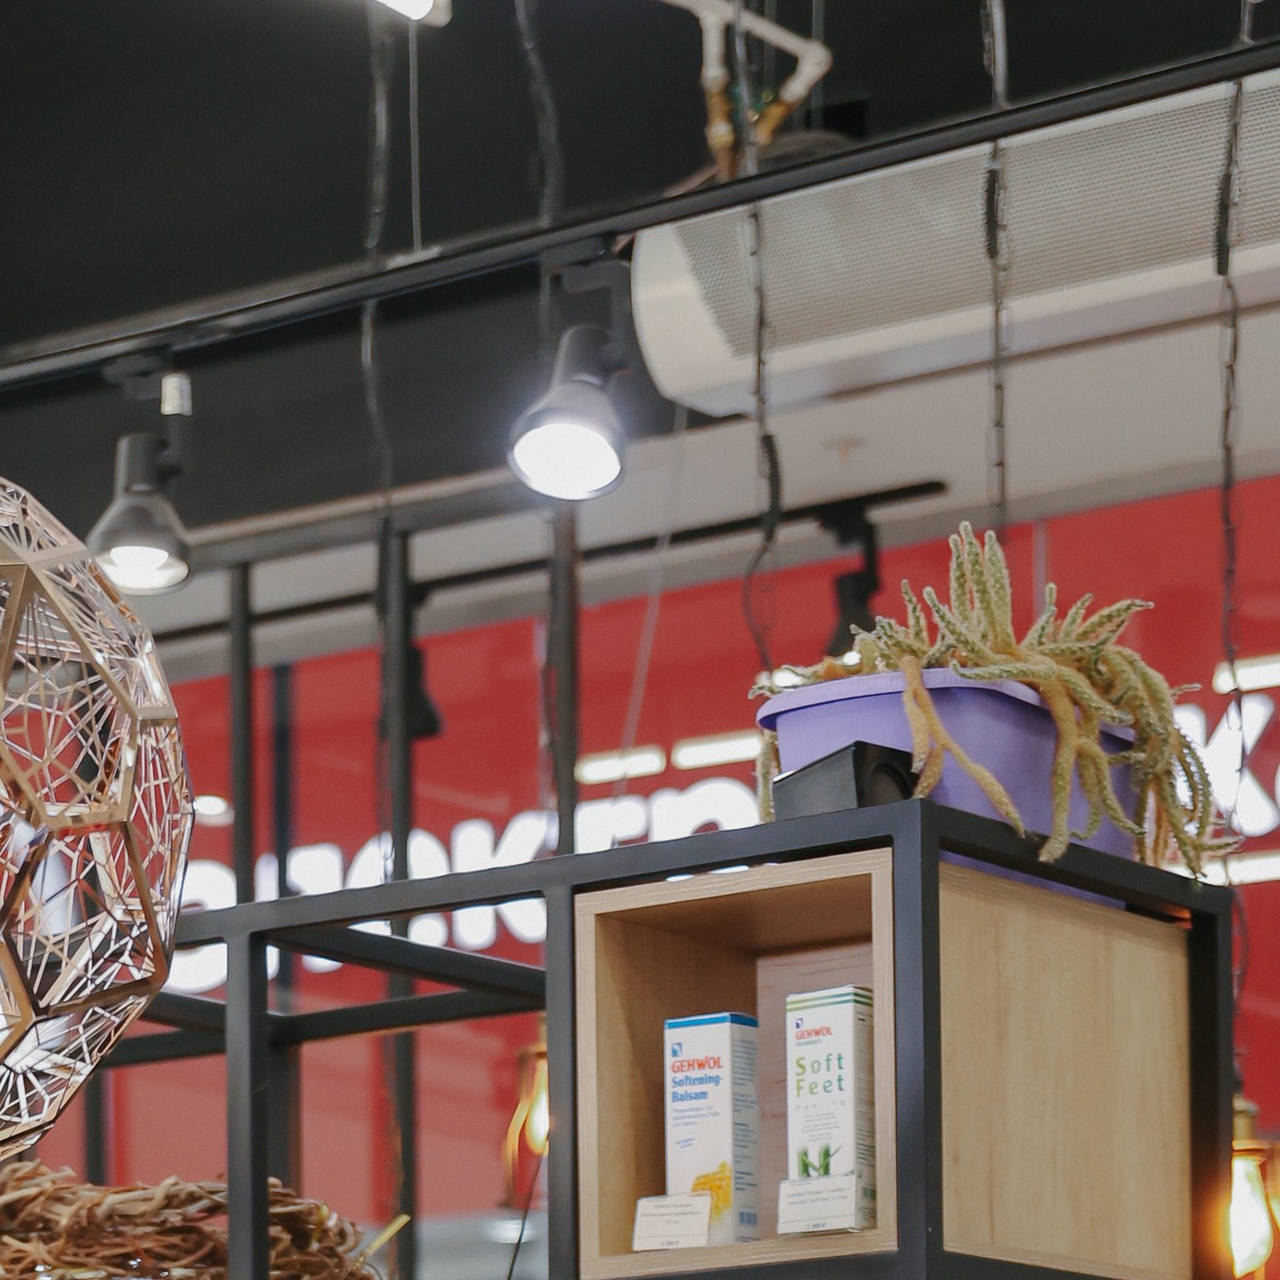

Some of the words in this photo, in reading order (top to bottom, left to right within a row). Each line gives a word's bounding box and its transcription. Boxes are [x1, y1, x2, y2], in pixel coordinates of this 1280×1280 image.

[796, 1027, 833, 1041] GEHWOL
[672, 1056, 723, 1073] GEHWOL
[796, 1053, 844, 1076] Soft
[672, 1074, 724, 1088] Softening-
[796, 1074, 845, 1098] Feet
[672, 1091, 709, 1103] Balsam
